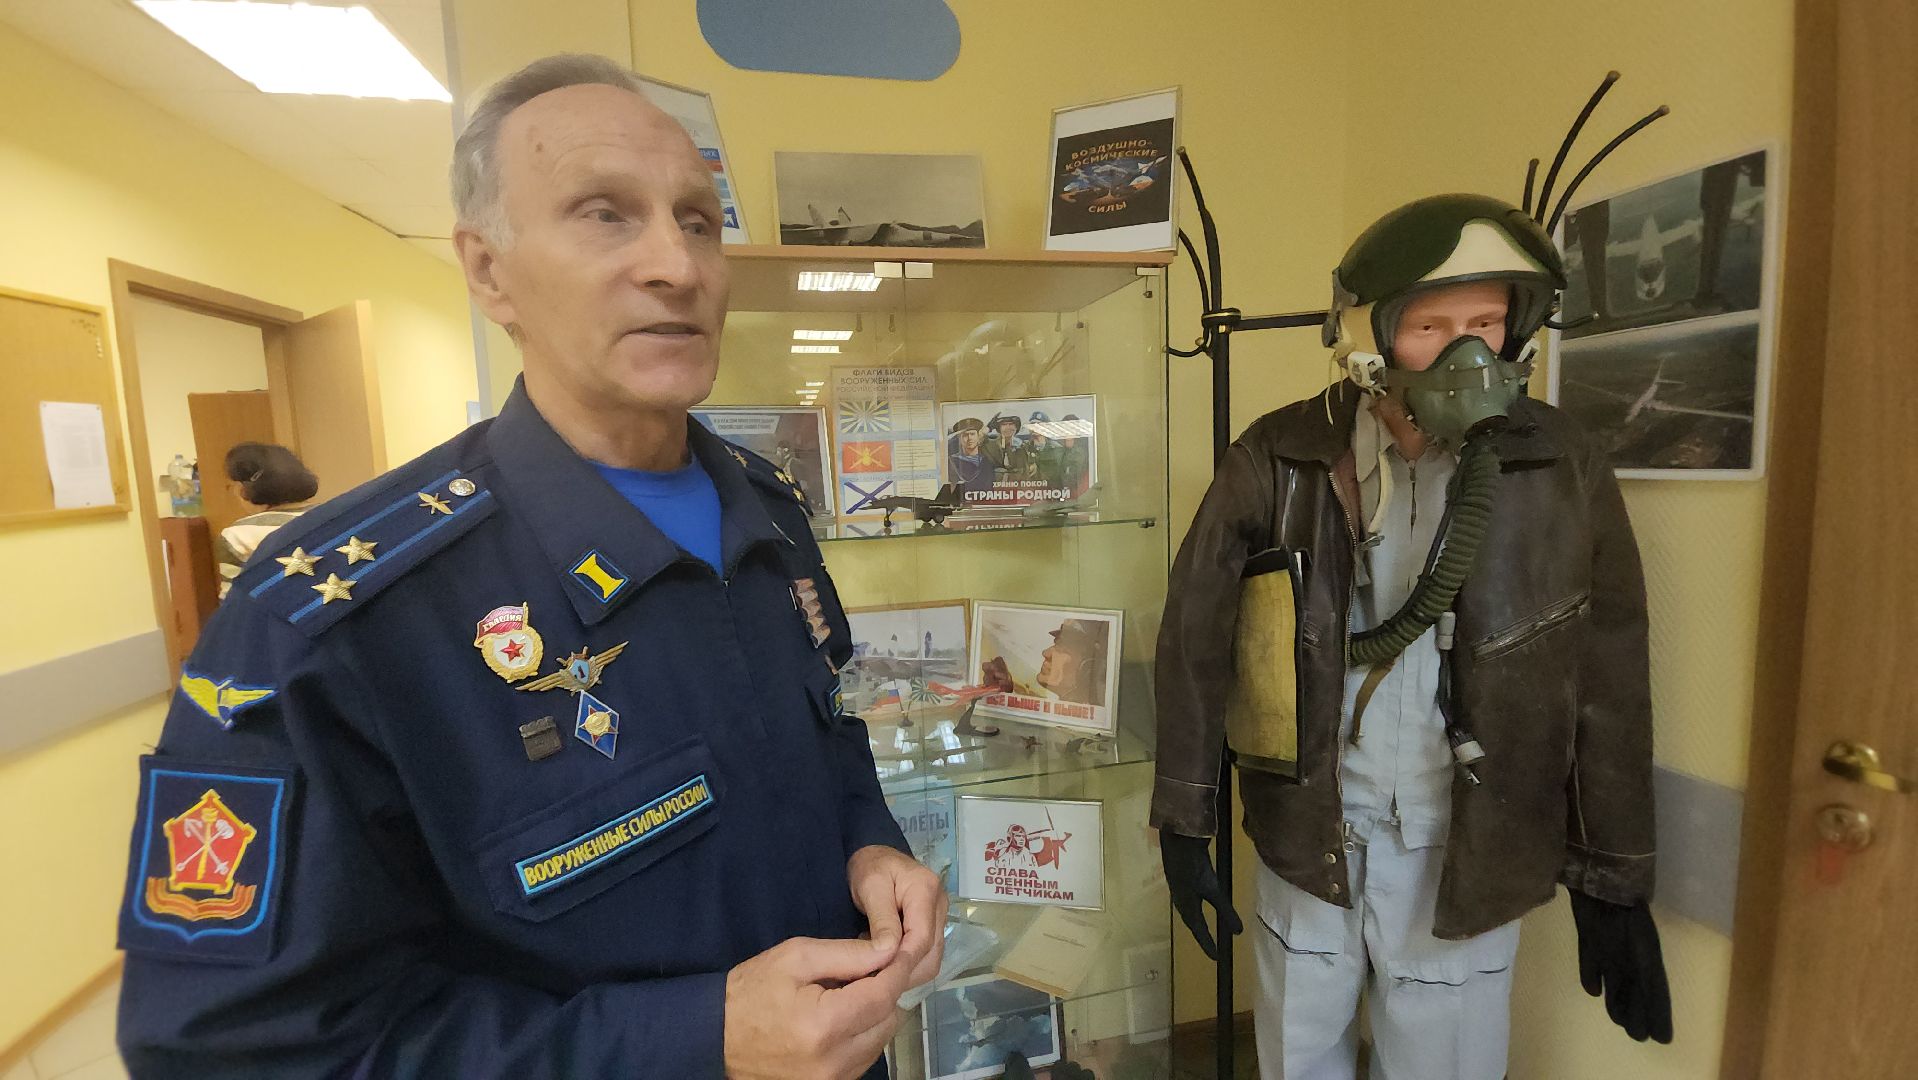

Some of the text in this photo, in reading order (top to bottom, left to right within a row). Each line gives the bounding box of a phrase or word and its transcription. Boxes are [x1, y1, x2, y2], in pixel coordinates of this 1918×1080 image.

[1071, 139, 1153, 161] ВОЗДУШНО-
[1065, 149, 1158, 172] КОСМИЧЕСКИЕ
[1088, 201, 1127, 213] СИЛЫ
[852, 368, 882, 377] ФЛАГИ
[992, 480, 1048, 488] ХРАНЮ ПОКОЙ
[964, 486, 1071, 501] СТРАНЫ РОДНОЙ
[523, 783, 708, 887] ВООРУЖЕННЫЕ СИЛЫ РОССИИ
[986, 866, 1039, 880] СЛАВА
[984, 875, 1059, 890] ВОЕННЫМ
[994, 886, 1074, 901] ЛЕТЧИКАМ
